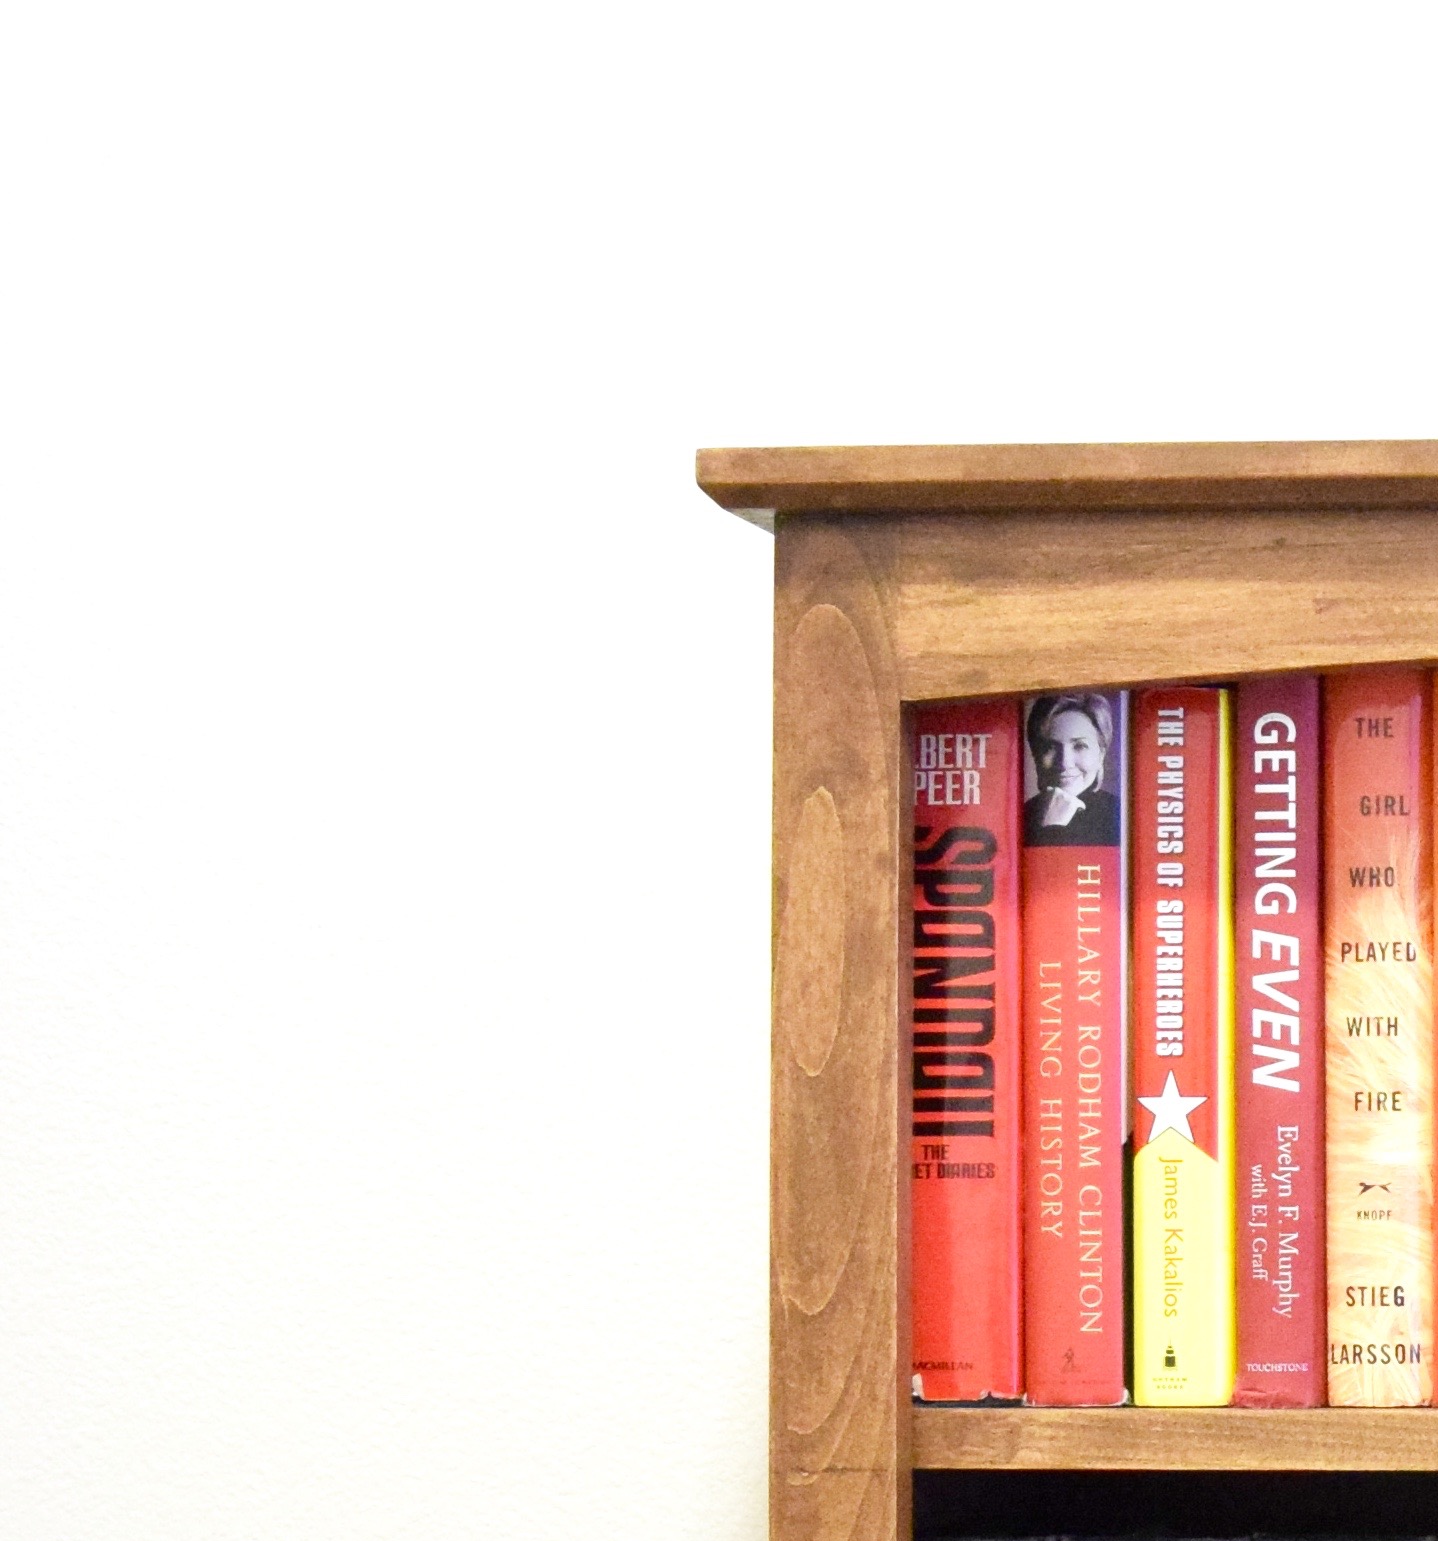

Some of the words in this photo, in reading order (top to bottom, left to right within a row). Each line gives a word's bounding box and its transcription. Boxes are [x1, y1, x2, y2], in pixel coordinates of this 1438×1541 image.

[1157, 707, 1185, 746] THE
[1355, 717, 1394, 738] THE
[1156, 753, 1185, 853] PHYSICS
[1252, 711, 1299, 914] GETTING
[1360, 795, 1409, 817] GIRL
[1156, 861, 1185, 887] OF
[1349, 867, 1396, 887] WHO
[1340, 942, 1417, 963] PLAYED
[1156, 899, 1185, 1058] SUPERHEROES
[1251, 931, 1302, 1092] EVEN
[1346, 1016, 1399, 1037] WITH
[1354, 1090, 1402, 1112] FIRE
[1157, 1157, 1184, 1219] James
[1163, 1226, 1181, 1318] Kakalios
[1346, 1285, 1406, 1308] STIEG
[1330, 1342, 1422, 1365] LARSSON
[1246, 1362, 1308, 1373] TOUCHSTONE
